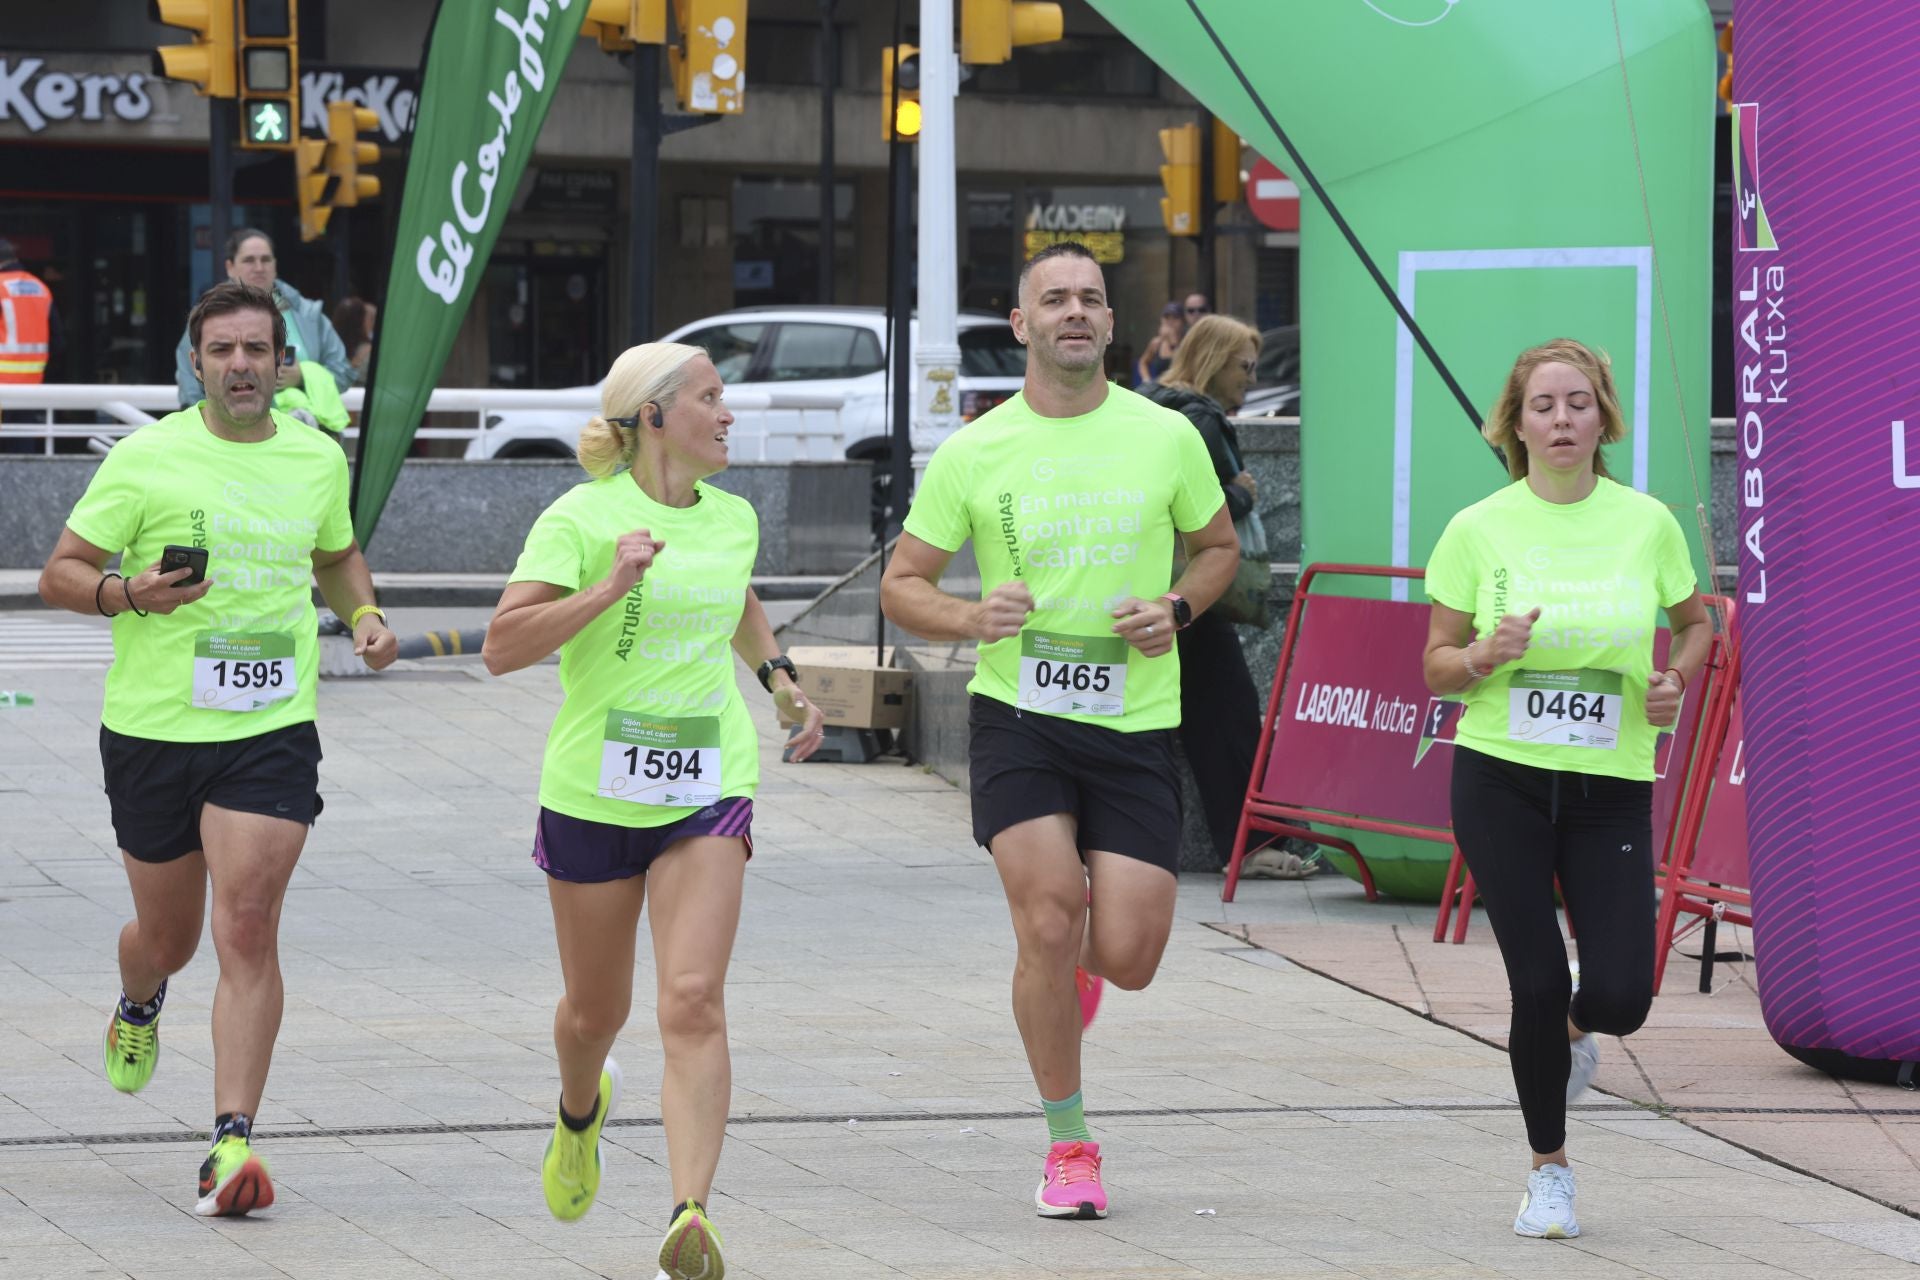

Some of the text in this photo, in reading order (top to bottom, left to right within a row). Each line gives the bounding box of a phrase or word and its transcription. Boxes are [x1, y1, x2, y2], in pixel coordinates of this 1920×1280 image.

[416, 221, 474, 305] El
[451, 70, 522, 234] Corte
[1025, 204, 1126, 230] ACADEMY
[1766, 265, 1788, 403] kutxa
[1739, 266, 1767, 604] LABORAL
[1020, 488, 1146, 514] En marcha
[212, 514, 242, 533] En
[999, 492, 1023, 577] ASTURIAS
[1021, 510, 1142, 542] contra el
[212, 540, 301, 561] contra
[1026, 541, 1140, 568] cáncer
[652, 578, 683, 600] En
[1514, 576, 1544, 593] En
[615, 579, 644, 662] ASTURIA
[648, 608, 734, 635] contra
[1034, 643, 1053, 651] contra
[1061, 646, 1084, 654] cáncer
[213, 660, 283, 688] 1595
[1035, 660, 1111, 692] 0465
[1295, 682, 1418, 735] LABORAL kutxa
[1527, 690, 1605, 723] 0464
[621, 726, 645, 735] contra
[645, 729, 654, 737] el
[655, 730, 678, 739] cáncer
[622, 717, 641, 727] Gijón
[623, 746, 702, 781] 1594
